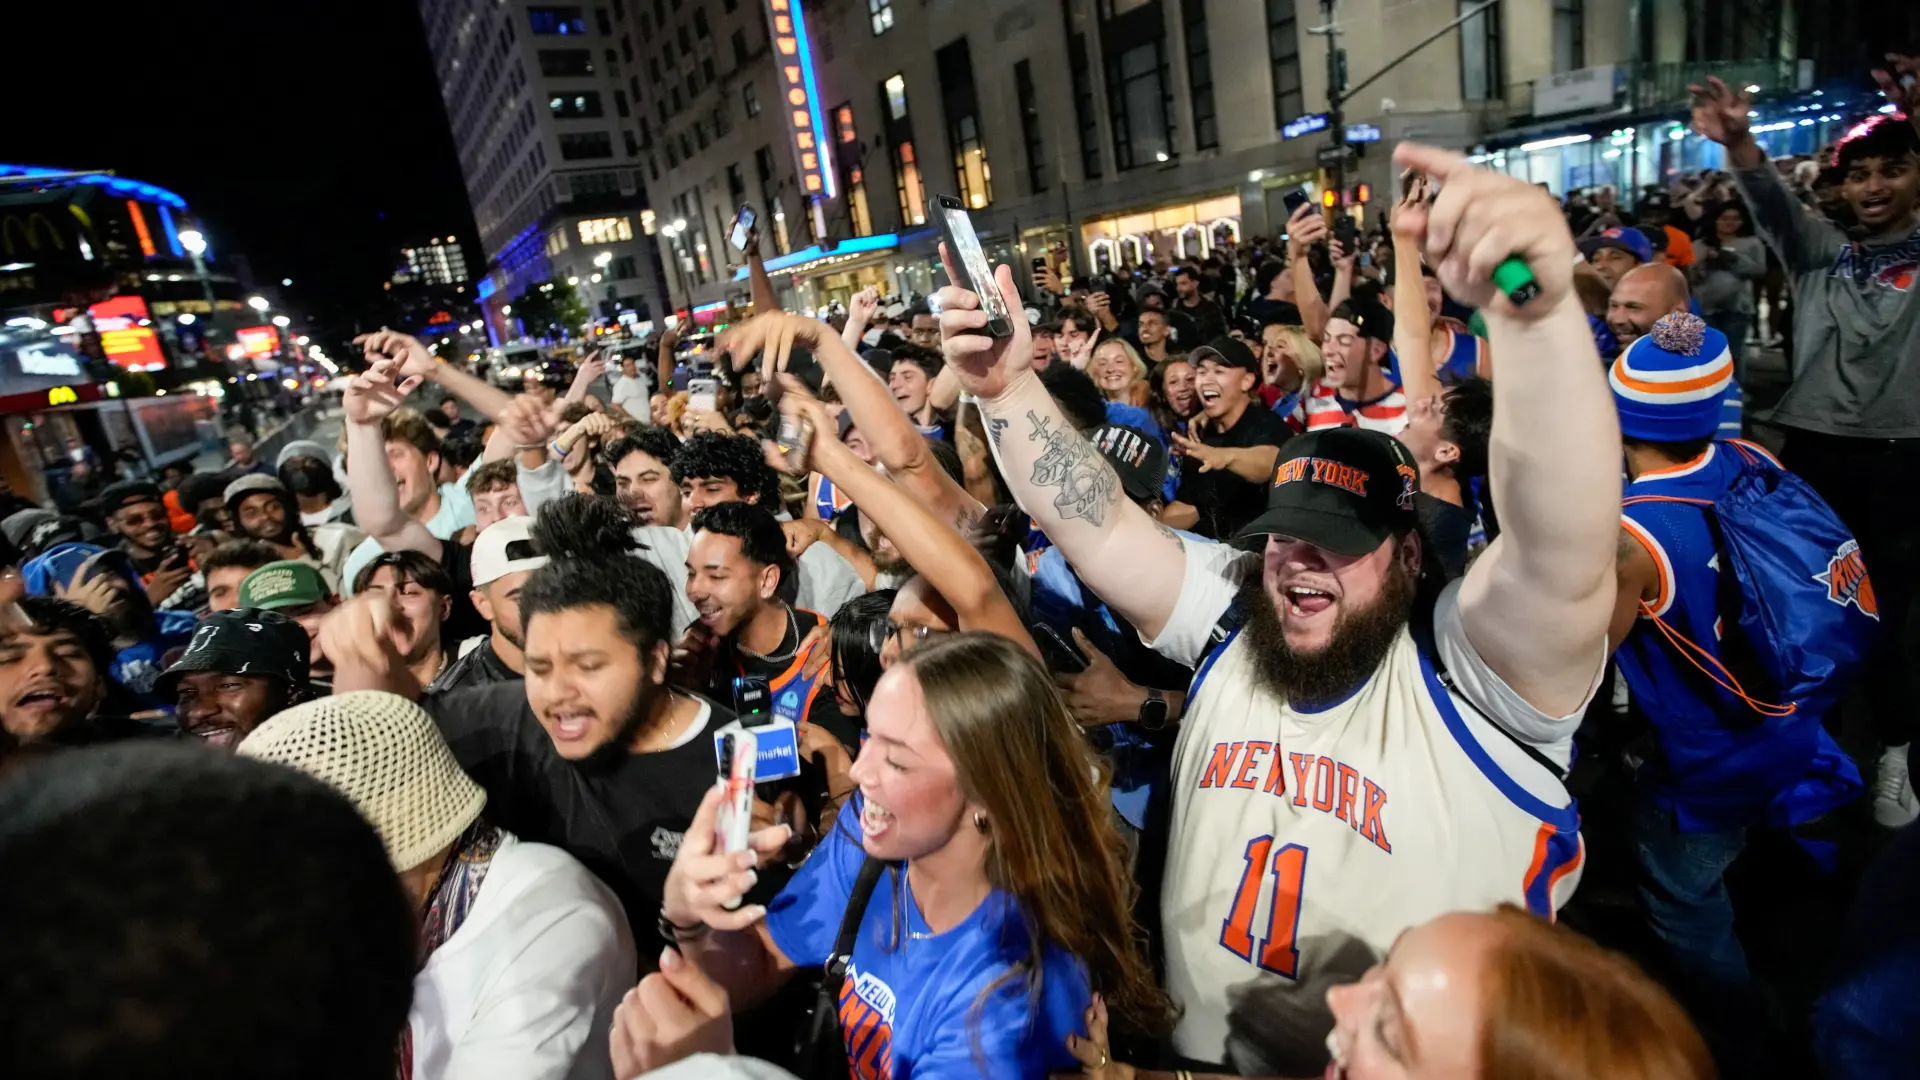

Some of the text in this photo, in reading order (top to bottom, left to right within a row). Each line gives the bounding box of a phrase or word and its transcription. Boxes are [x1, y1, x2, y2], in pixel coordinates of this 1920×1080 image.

[770, 0, 821, 191] NEW YORKER
[1275, 457, 1311, 487] NEW
[1311, 457, 1370, 497] YORK
[757, 744, 793, 762] market
[1199, 740, 1392, 855] NEW YORK
[1219, 834, 1309, 980] 11
[857, 979, 890, 1009] NEW
